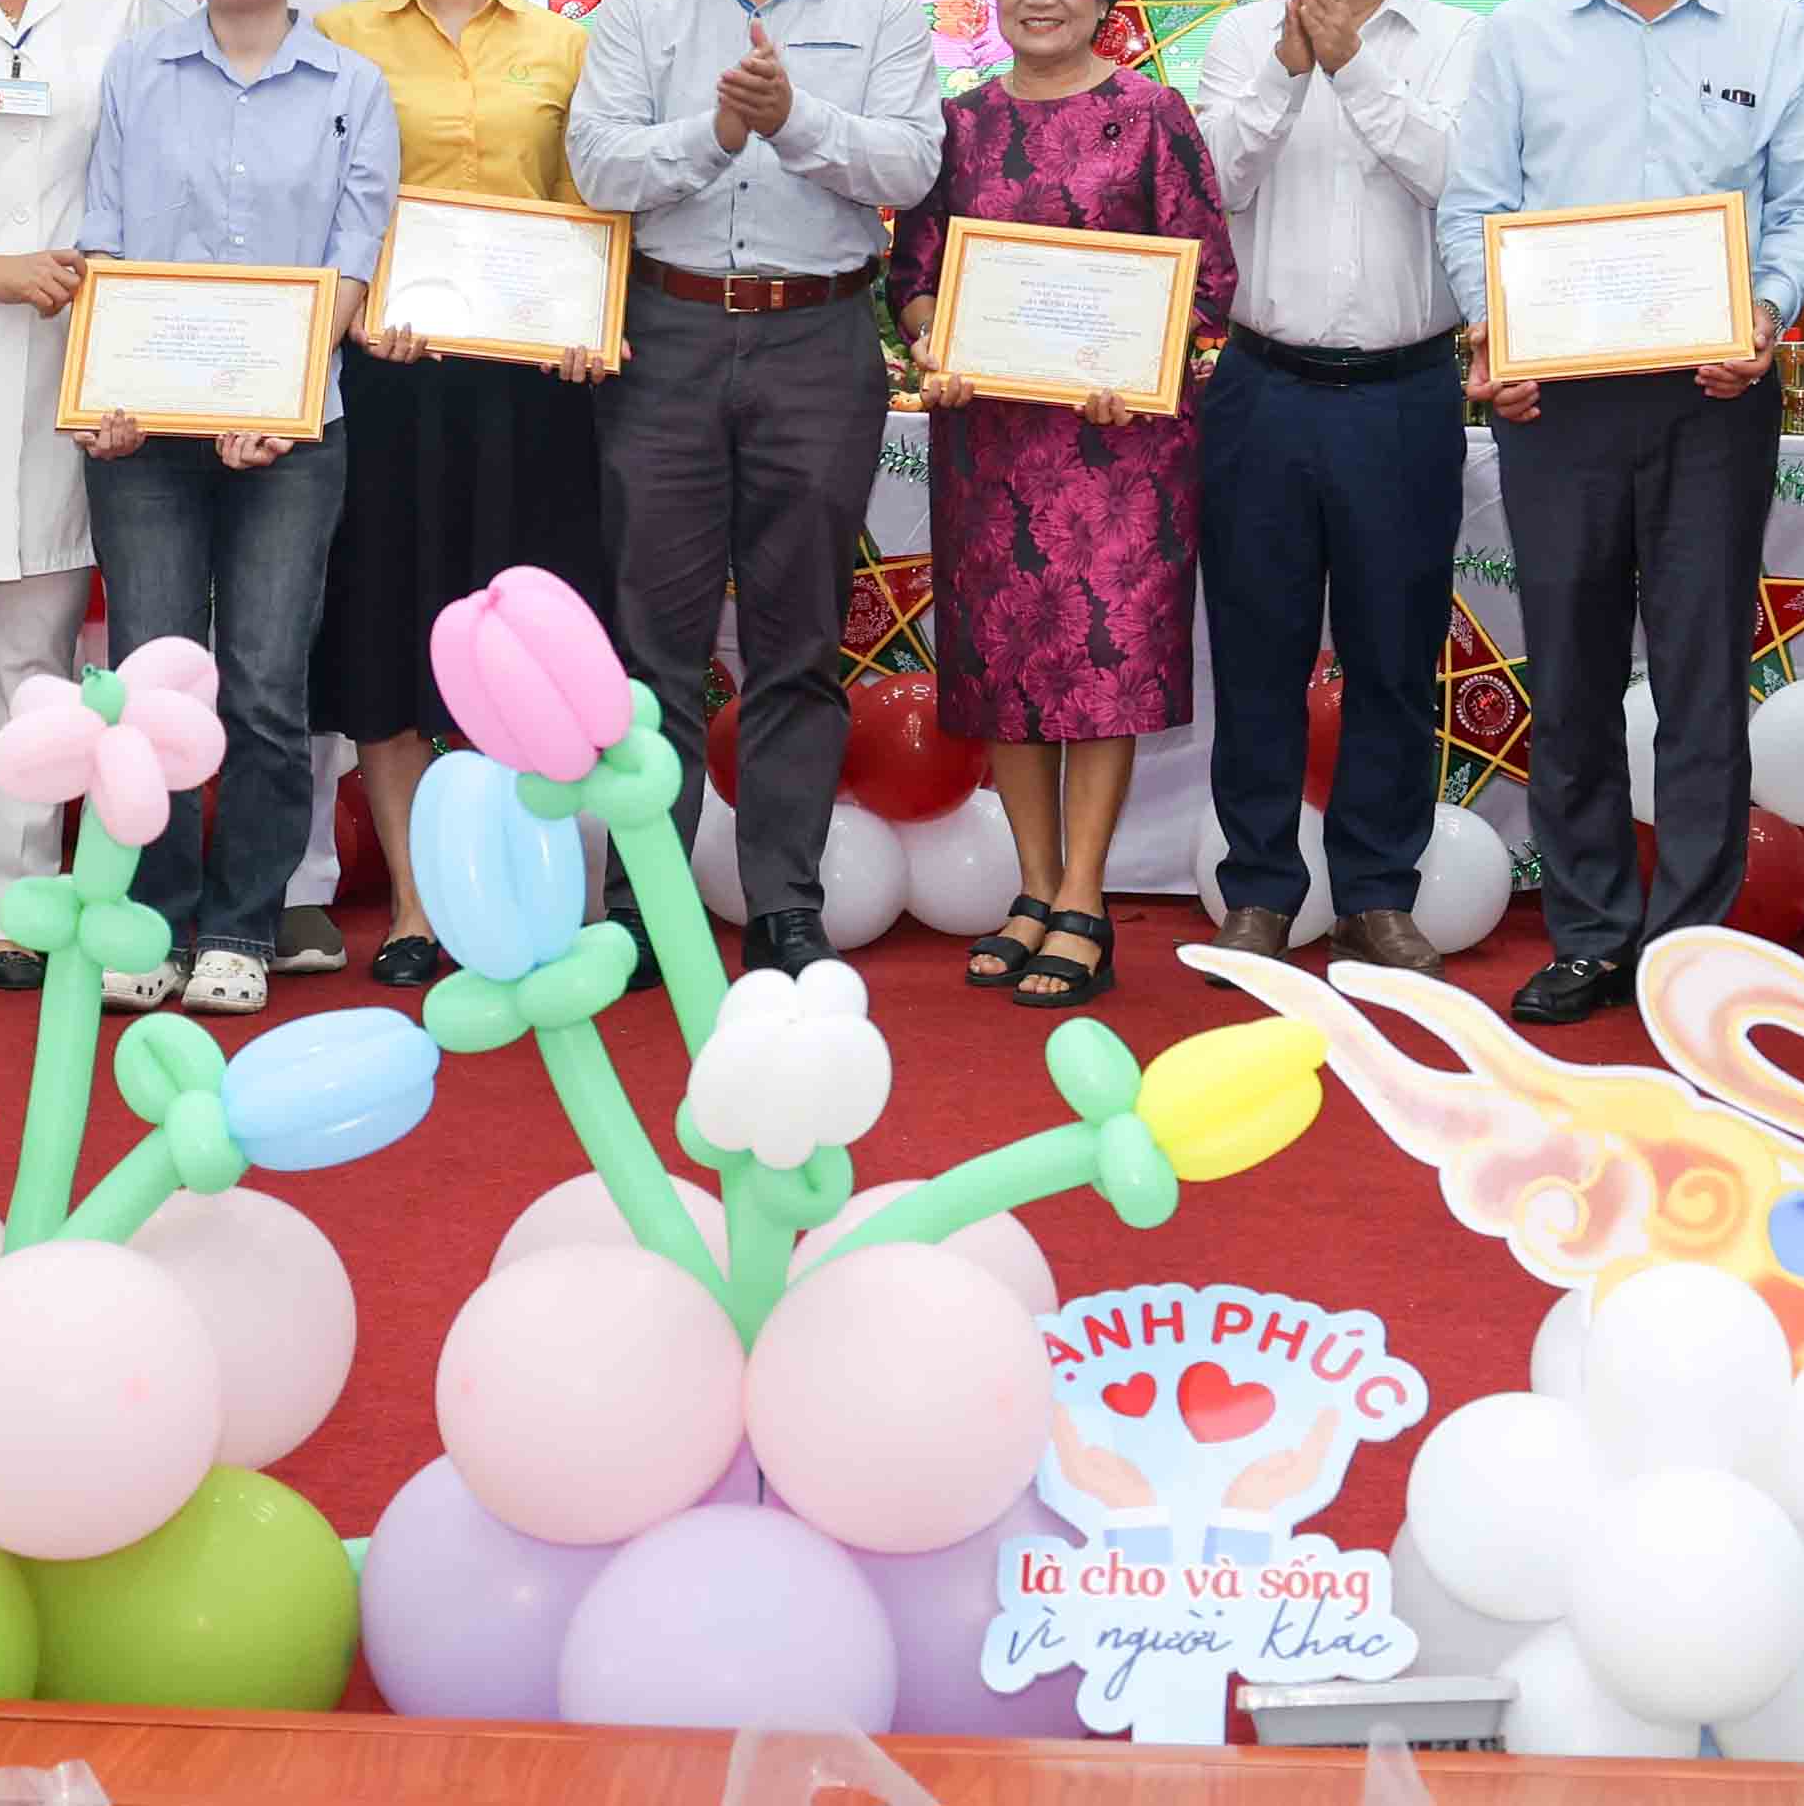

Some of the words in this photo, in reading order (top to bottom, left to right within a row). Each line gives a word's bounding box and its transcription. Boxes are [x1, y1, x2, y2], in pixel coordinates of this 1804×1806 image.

[1042, 1300, 1185, 1382] ẠNH
[1211, 1302, 1408, 1419] PHÚC
[1020, 1552, 1065, 1596] là
[1079, 1551, 1167, 1596] cho
[1182, 1557, 1243, 1600] và
[1258, 1554, 1372, 1616] sống
[1096, 1609, 1233, 1702] người
